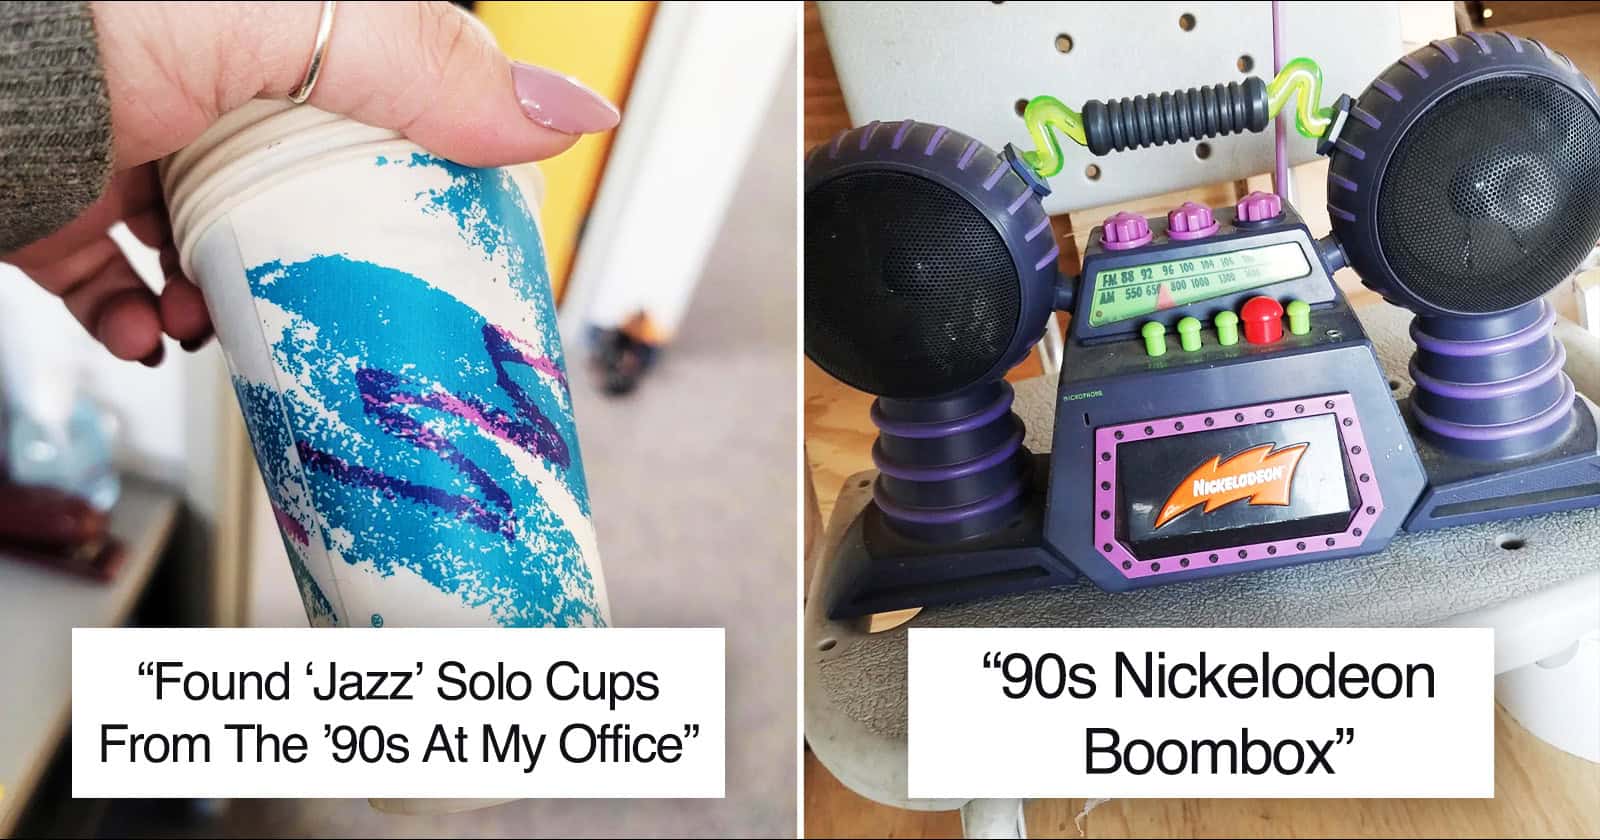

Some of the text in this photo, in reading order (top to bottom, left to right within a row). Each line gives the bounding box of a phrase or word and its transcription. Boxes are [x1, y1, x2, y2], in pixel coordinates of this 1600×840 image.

[1103, 273, 1117, 288] FM
[1121, 270, 1134, 284] 88
[1140, 267, 1153, 280] 92
[1162, 264, 1175, 276] 96
[1179, 261, 1194, 273] 100
[1099, 290, 1115, 305] AM
[1125, 286, 1143, 300] 550
[1170, 279, 1187, 292] 800
[1191, 276, 1210, 289] 1000
[1193, 465, 1283, 497] NICKELODEON
